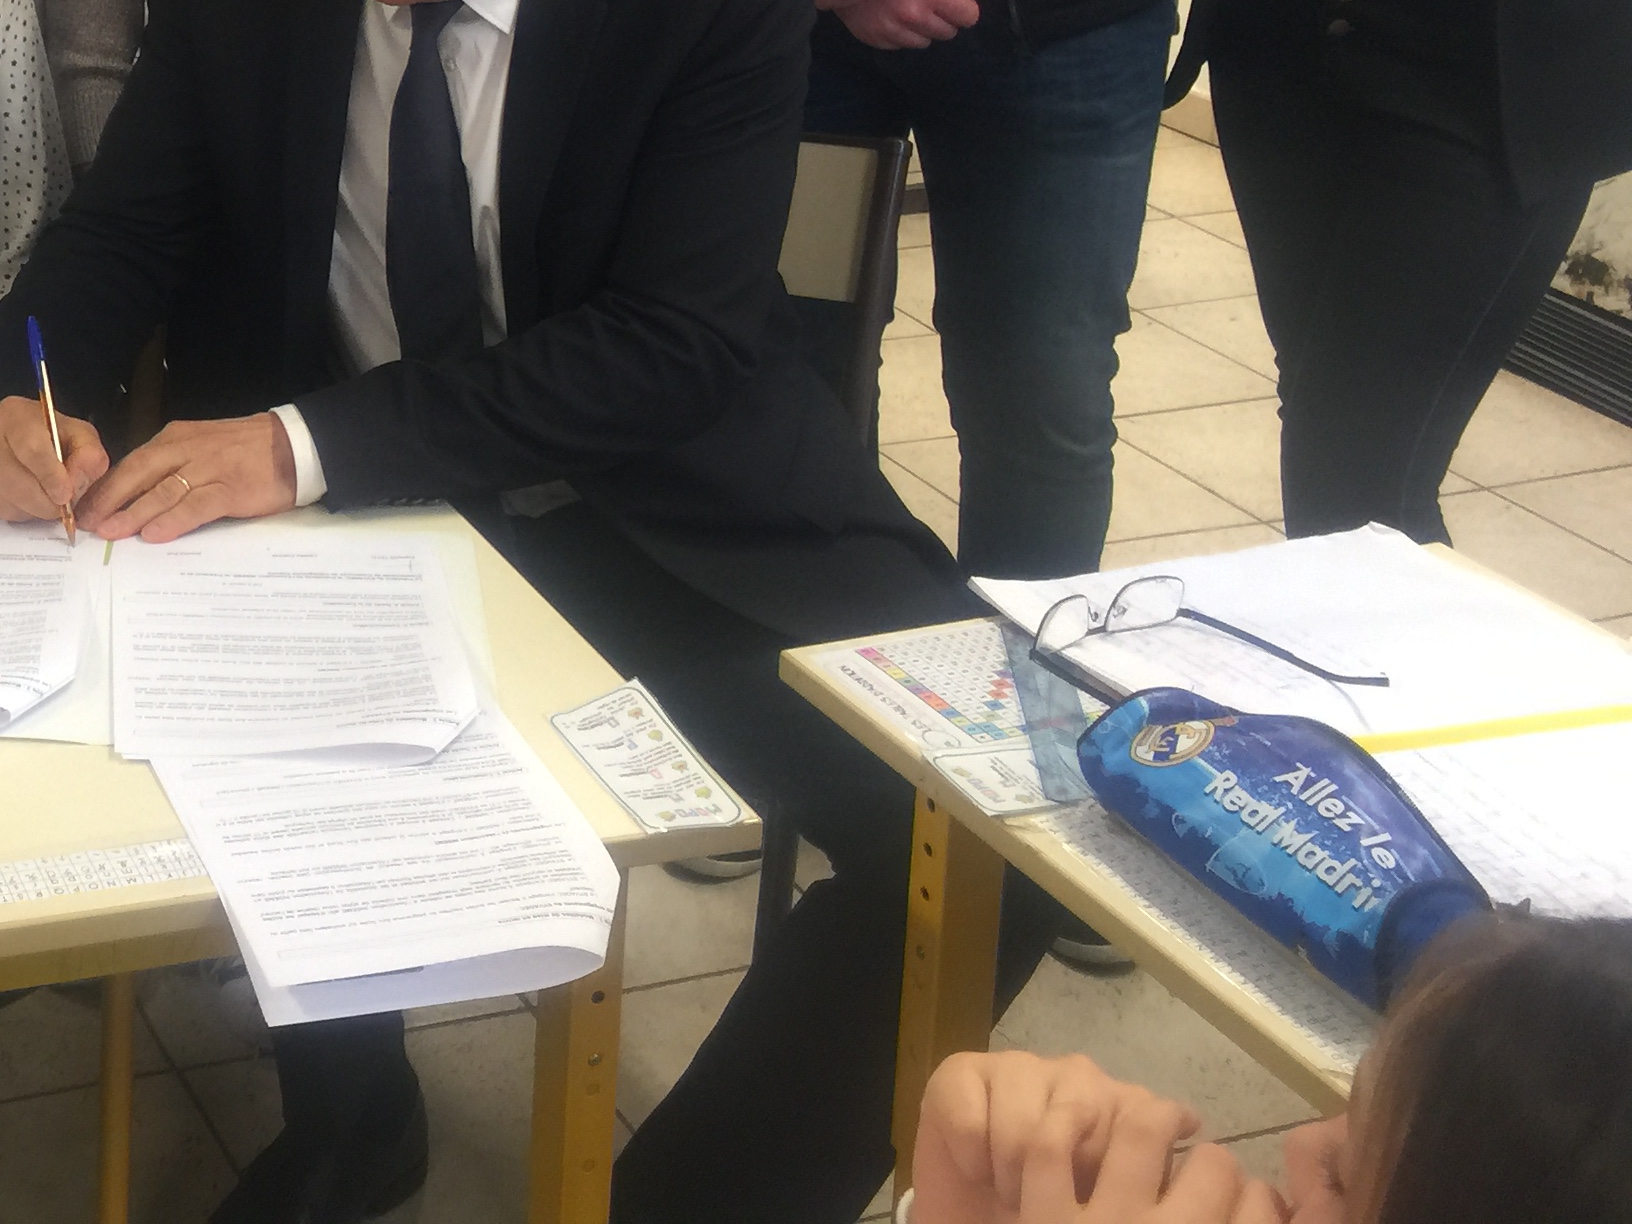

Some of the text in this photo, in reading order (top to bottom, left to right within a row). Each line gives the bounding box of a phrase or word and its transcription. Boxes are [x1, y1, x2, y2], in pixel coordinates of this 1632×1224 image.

[1204, 770, 1382, 913] Real Madri
[1273, 762, 1399, 871] Allez le
